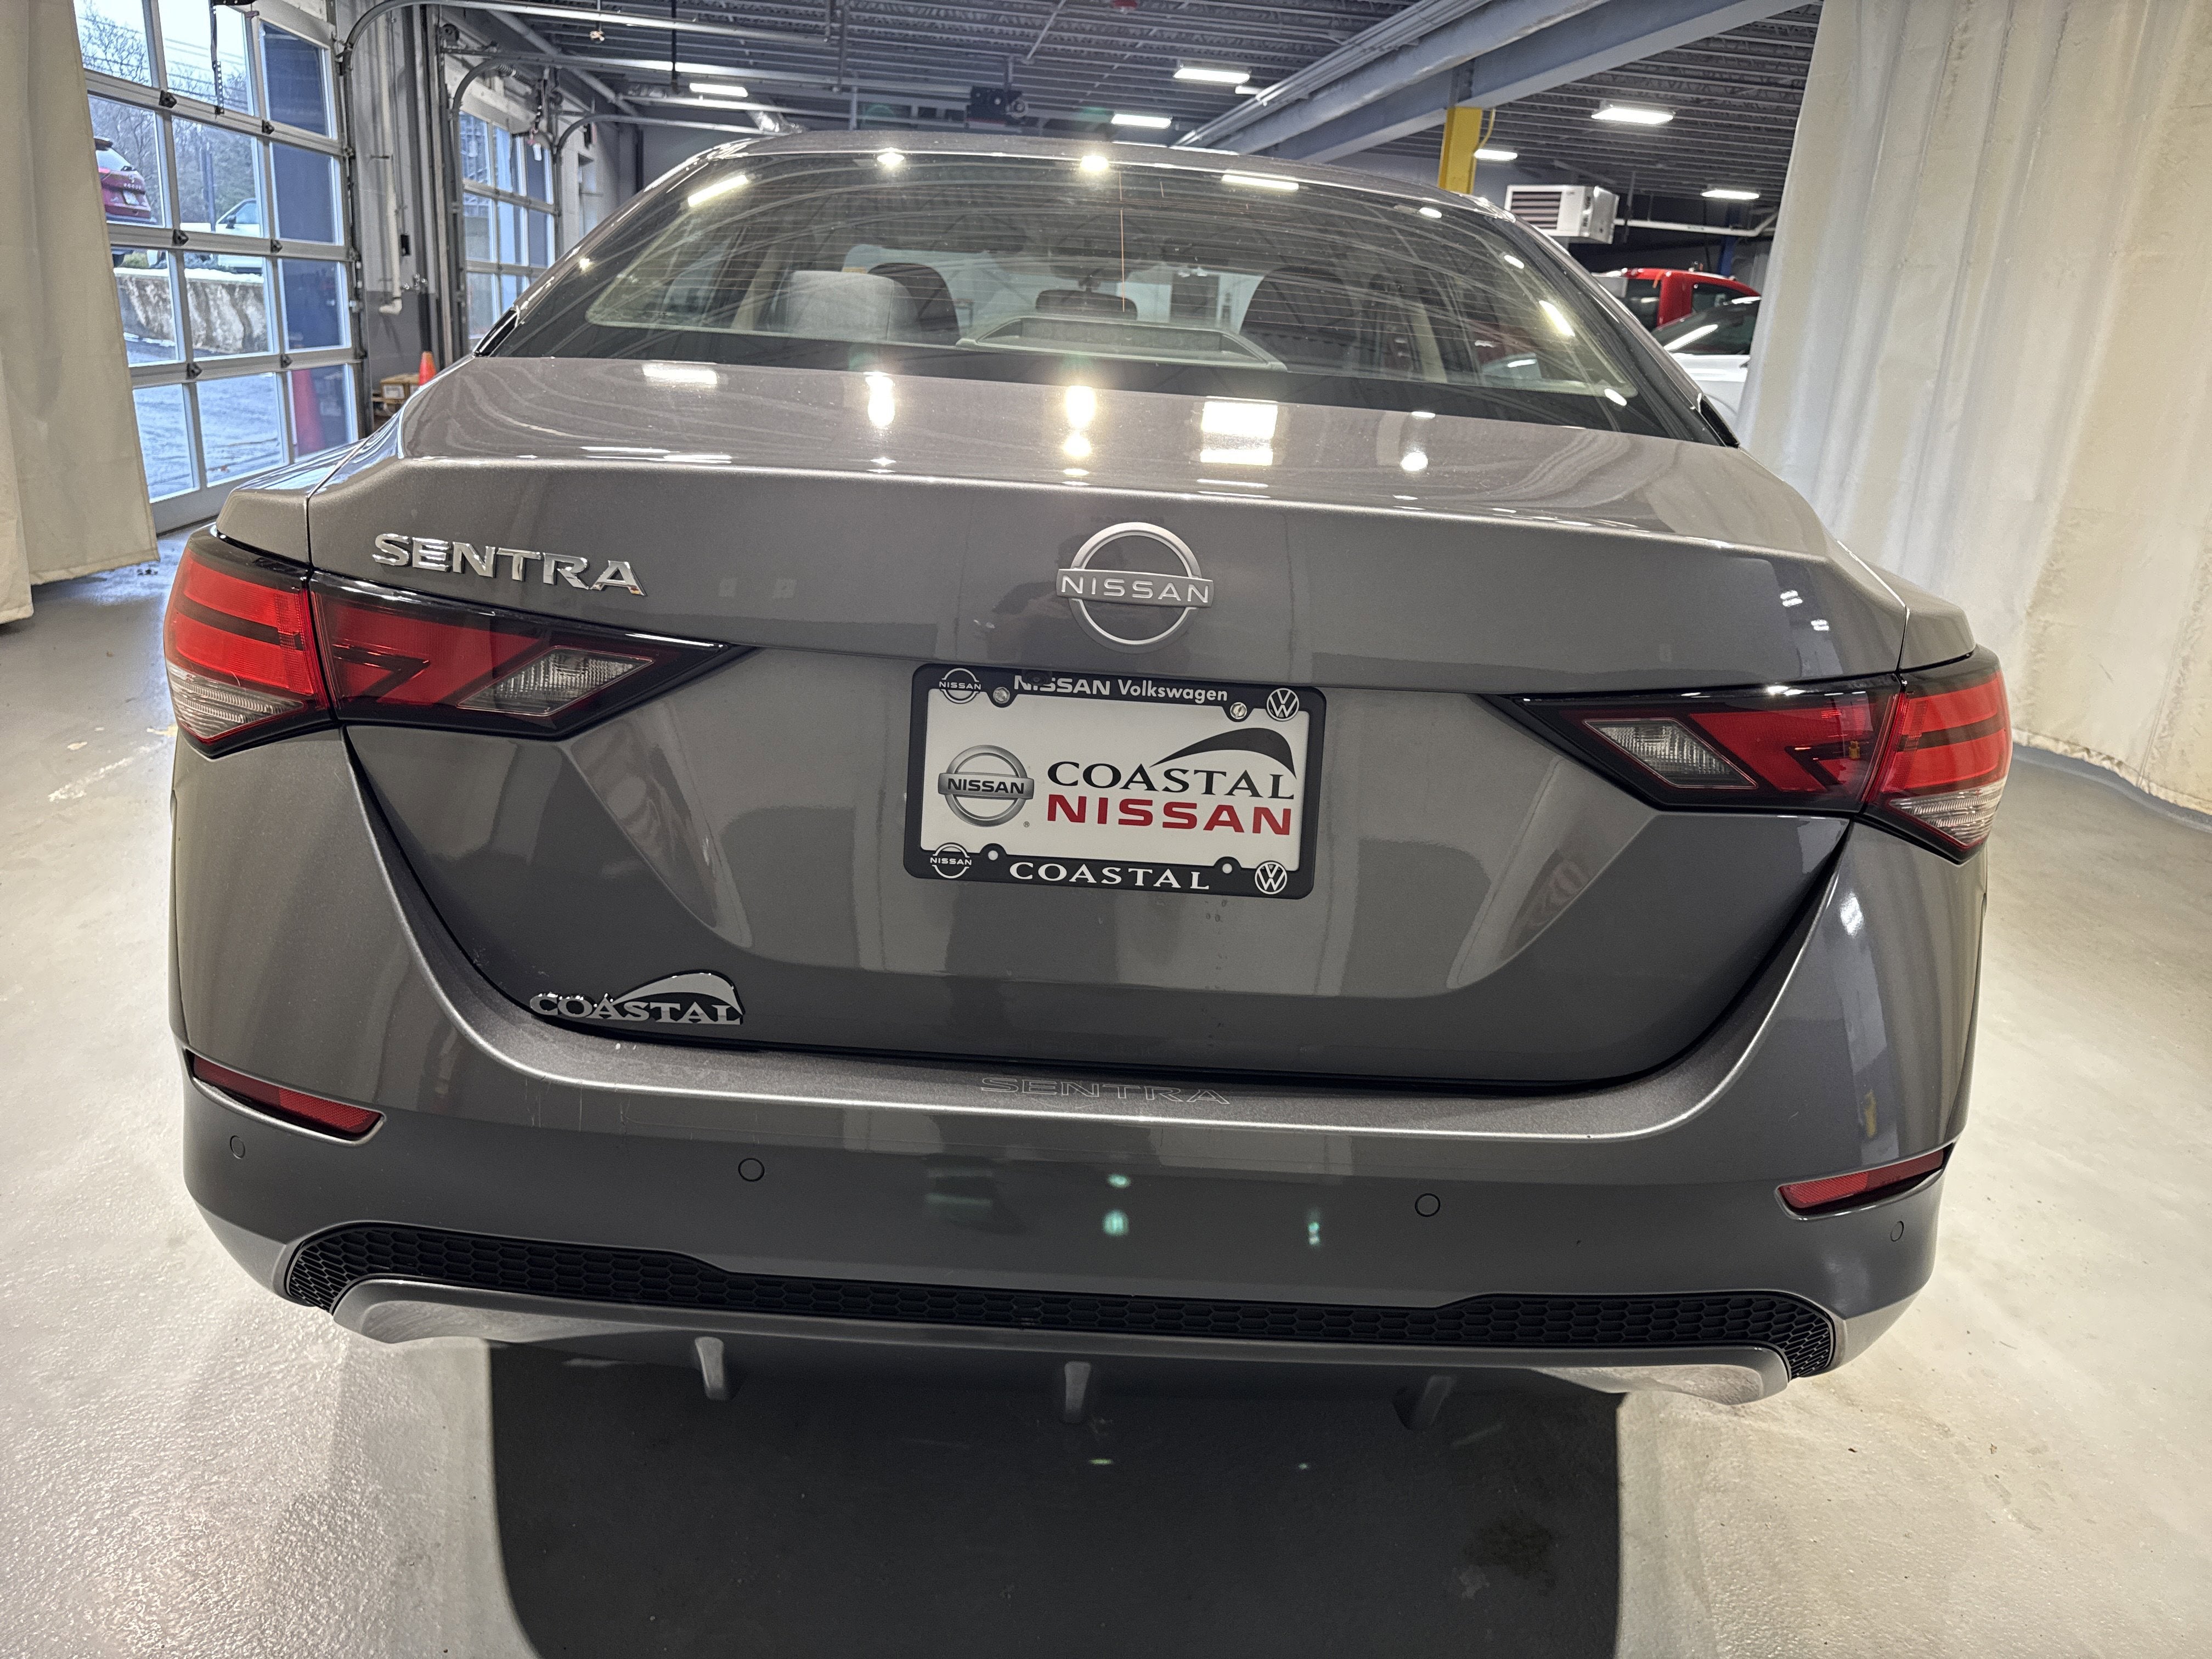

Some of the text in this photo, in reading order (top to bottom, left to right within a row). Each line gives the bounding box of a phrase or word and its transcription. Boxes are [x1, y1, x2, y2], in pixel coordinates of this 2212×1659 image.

[372, 533, 646, 596] SENTRA
[1062, 575, 1209, 603] NISSAN
[939, 681, 981, 690] NISSAN
[1118, 679, 1228, 704] Volkswagen
[947, 778, 1024, 794] NISSAN
[1047, 761, 1295, 799] COASTAL
[1047, 794, 1291, 836] NISSAN
[930, 857, 972, 866] NISSAN
[1009, 862, 1209, 890] COASTAL
[530, 992, 744, 1025] COASTAL
[981, 1077, 1230, 1104] SENTRA
